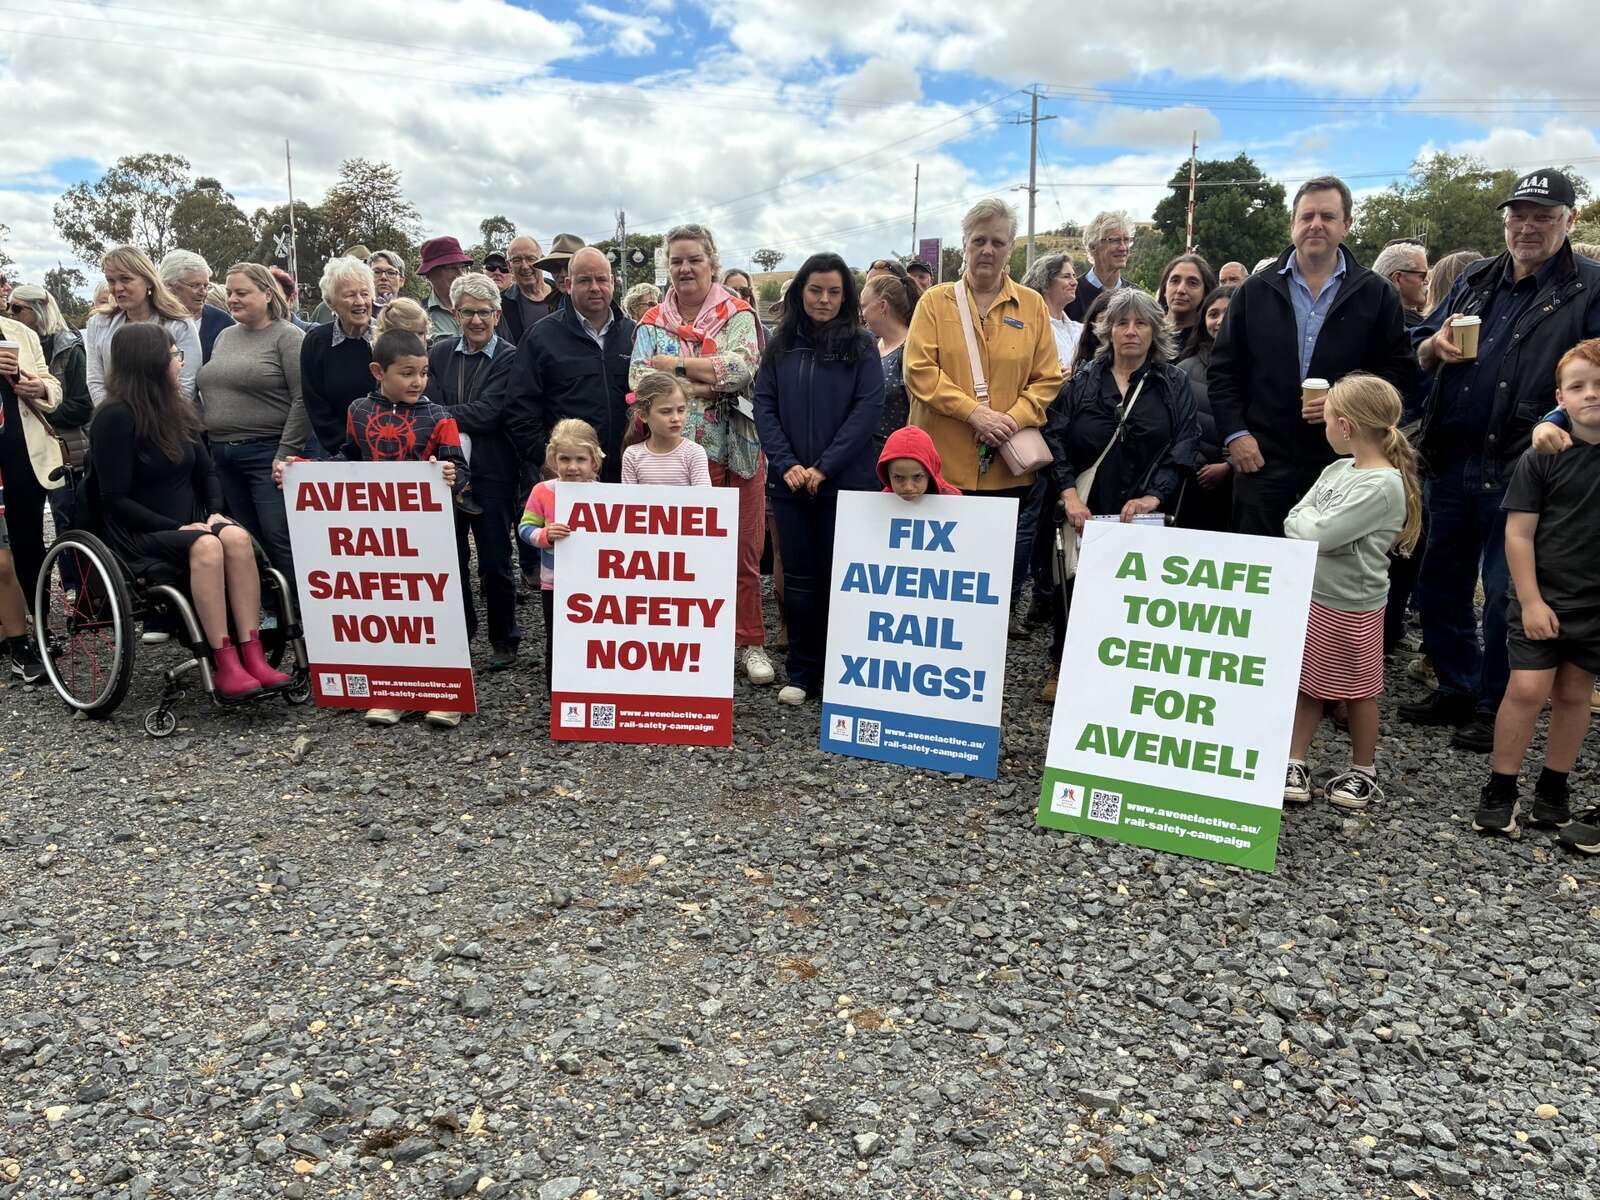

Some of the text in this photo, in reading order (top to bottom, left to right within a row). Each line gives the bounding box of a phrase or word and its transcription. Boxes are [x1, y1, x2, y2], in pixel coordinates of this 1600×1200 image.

[1518, 176, 1548, 189] AAA
[297, 482, 442, 512] AVENEL
[569, 503, 727, 537] AVENEL
[889, 519, 956, 553] FIX
[330, 528, 419, 558] RAIL
[599, 549, 695, 581] RAIL
[1116, 553, 1271, 594] A SAFE
[309, 571, 449, 602] SAFETY
[841, 562, 999, 605] AVENEL
[567, 593, 724, 628] SAFETY
[1124, 595, 1252, 638] TOWN
[334, 615, 436, 644] NOW!
[868, 611, 962, 650] RAIL
[587, 639, 701, 673] NOW!
[1098, 637, 1266, 687] CENTRE
[372, 680, 461, 689] www.avenelactive.au/
[373, 690, 458, 700] rail-safety-campaign
[839, 655, 986, 703] XINGS!
[620, 710, 720, 720] www.avenelactive.au/
[1130, 686, 1217, 726] FOR
[619, 721, 714, 732] rail-safety-campaign
[885, 728, 985, 749] www.avenelactive.au/
[883, 740, 979, 762] rail-safety-campaign
[1076, 724, 1258, 780] AVENEL!
[1125, 817, 1251, 849] rail-safety-campaign
[1127, 802, 1261, 834] www.avenelactive.au/
